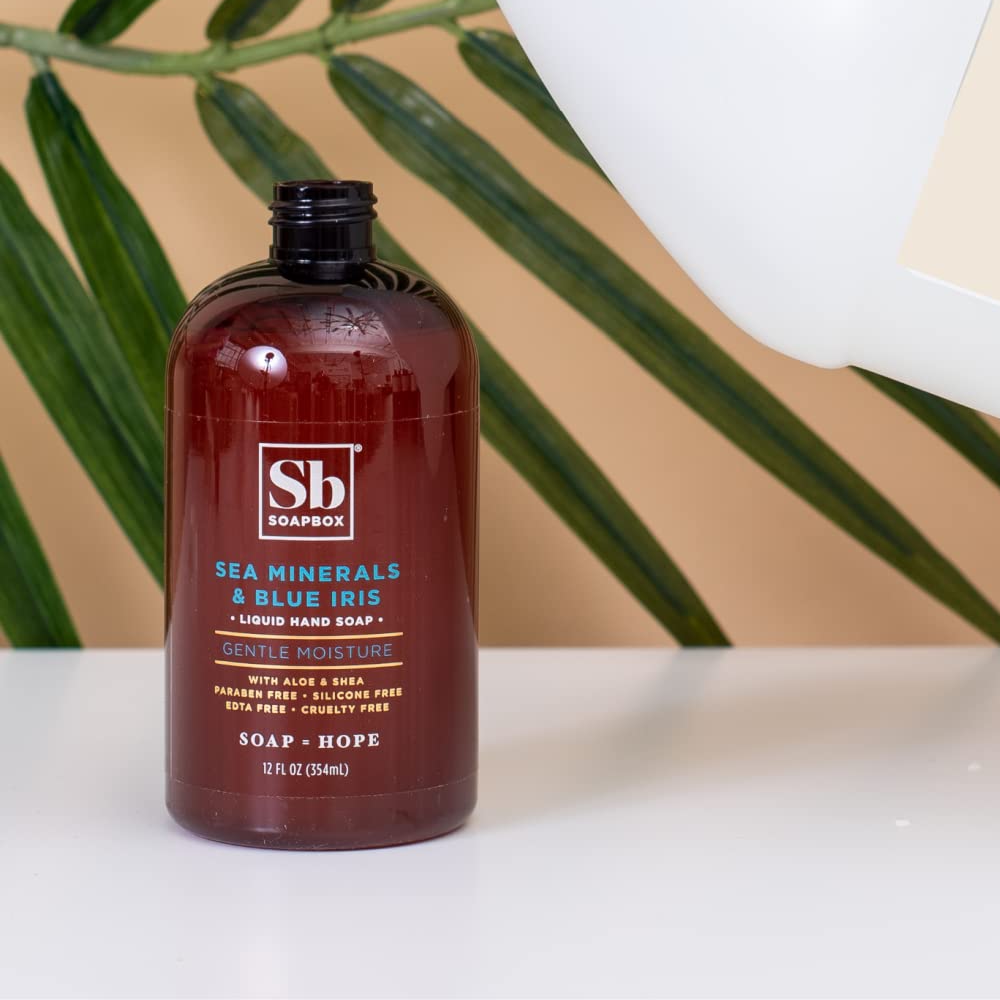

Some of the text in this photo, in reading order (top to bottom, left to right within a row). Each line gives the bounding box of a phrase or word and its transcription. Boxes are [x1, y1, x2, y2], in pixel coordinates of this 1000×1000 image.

[267, 458, 347, 511] Sb
[267, 514, 346, 529] SOAPBOX
[215, 560, 401, 583] SEA MINERALS
[231, 587, 381, 608] & BLUE IRIS
[239, 613, 374, 628] LIQUID HAND SOAP
[221, 640, 393, 661] GENTLE MOISTURE
[247, 674, 365, 687] WITH ALOE & SHEA
[213, 684, 403, 702] PARABEN FREE SILICONE FREE
[225, 700, 390, 715] EDTA FREE CRUELTY FREE
[238, 731, 295, 749] SOAP
[317, 732, 380, 749] HOPE
[262, 761, 349, 778] 12 FL OZ (354mL)
